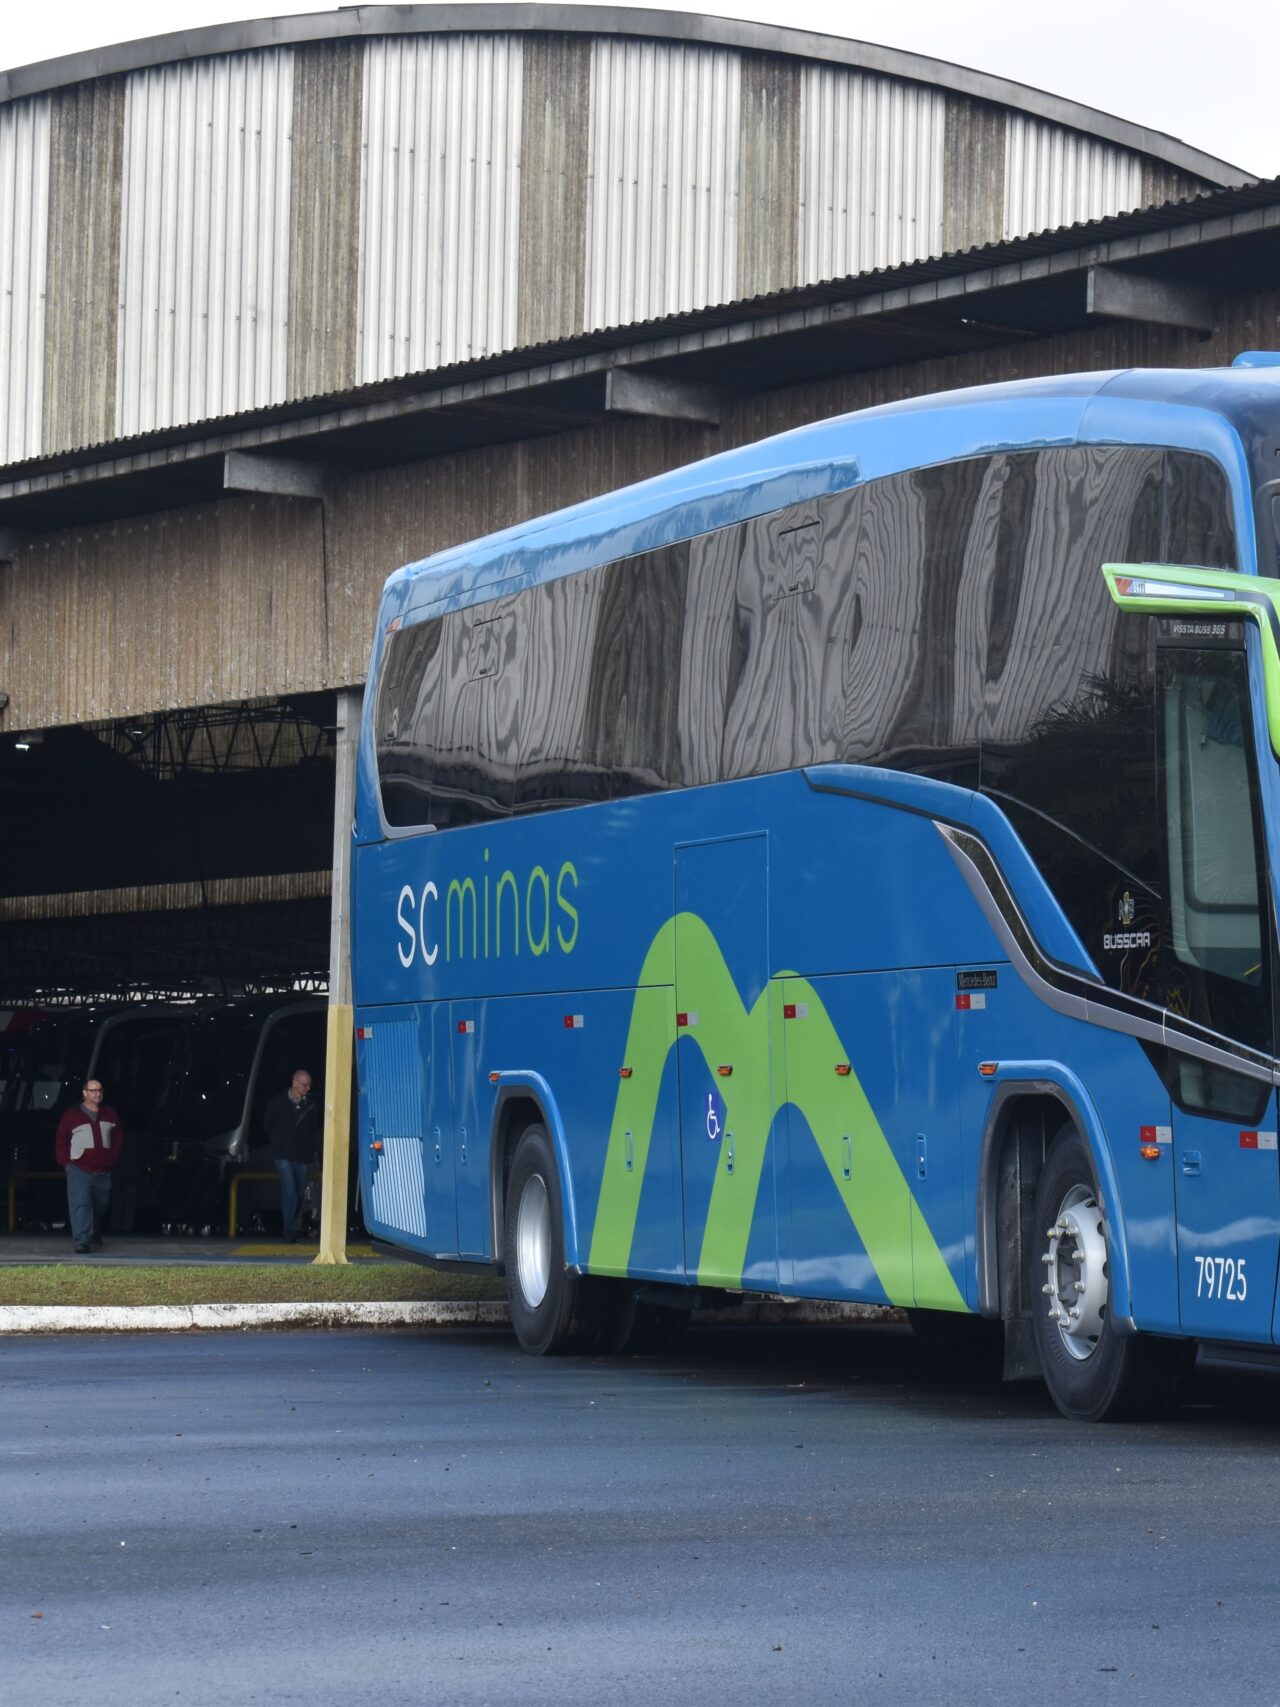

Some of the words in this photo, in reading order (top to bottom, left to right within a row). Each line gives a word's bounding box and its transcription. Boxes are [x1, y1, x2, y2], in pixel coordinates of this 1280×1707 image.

[1211, 624, 1226, 635] 365
[1103, 932, 1151, 950] BUSSCAR
[1194, 1256, 1247, 1301] 79725
